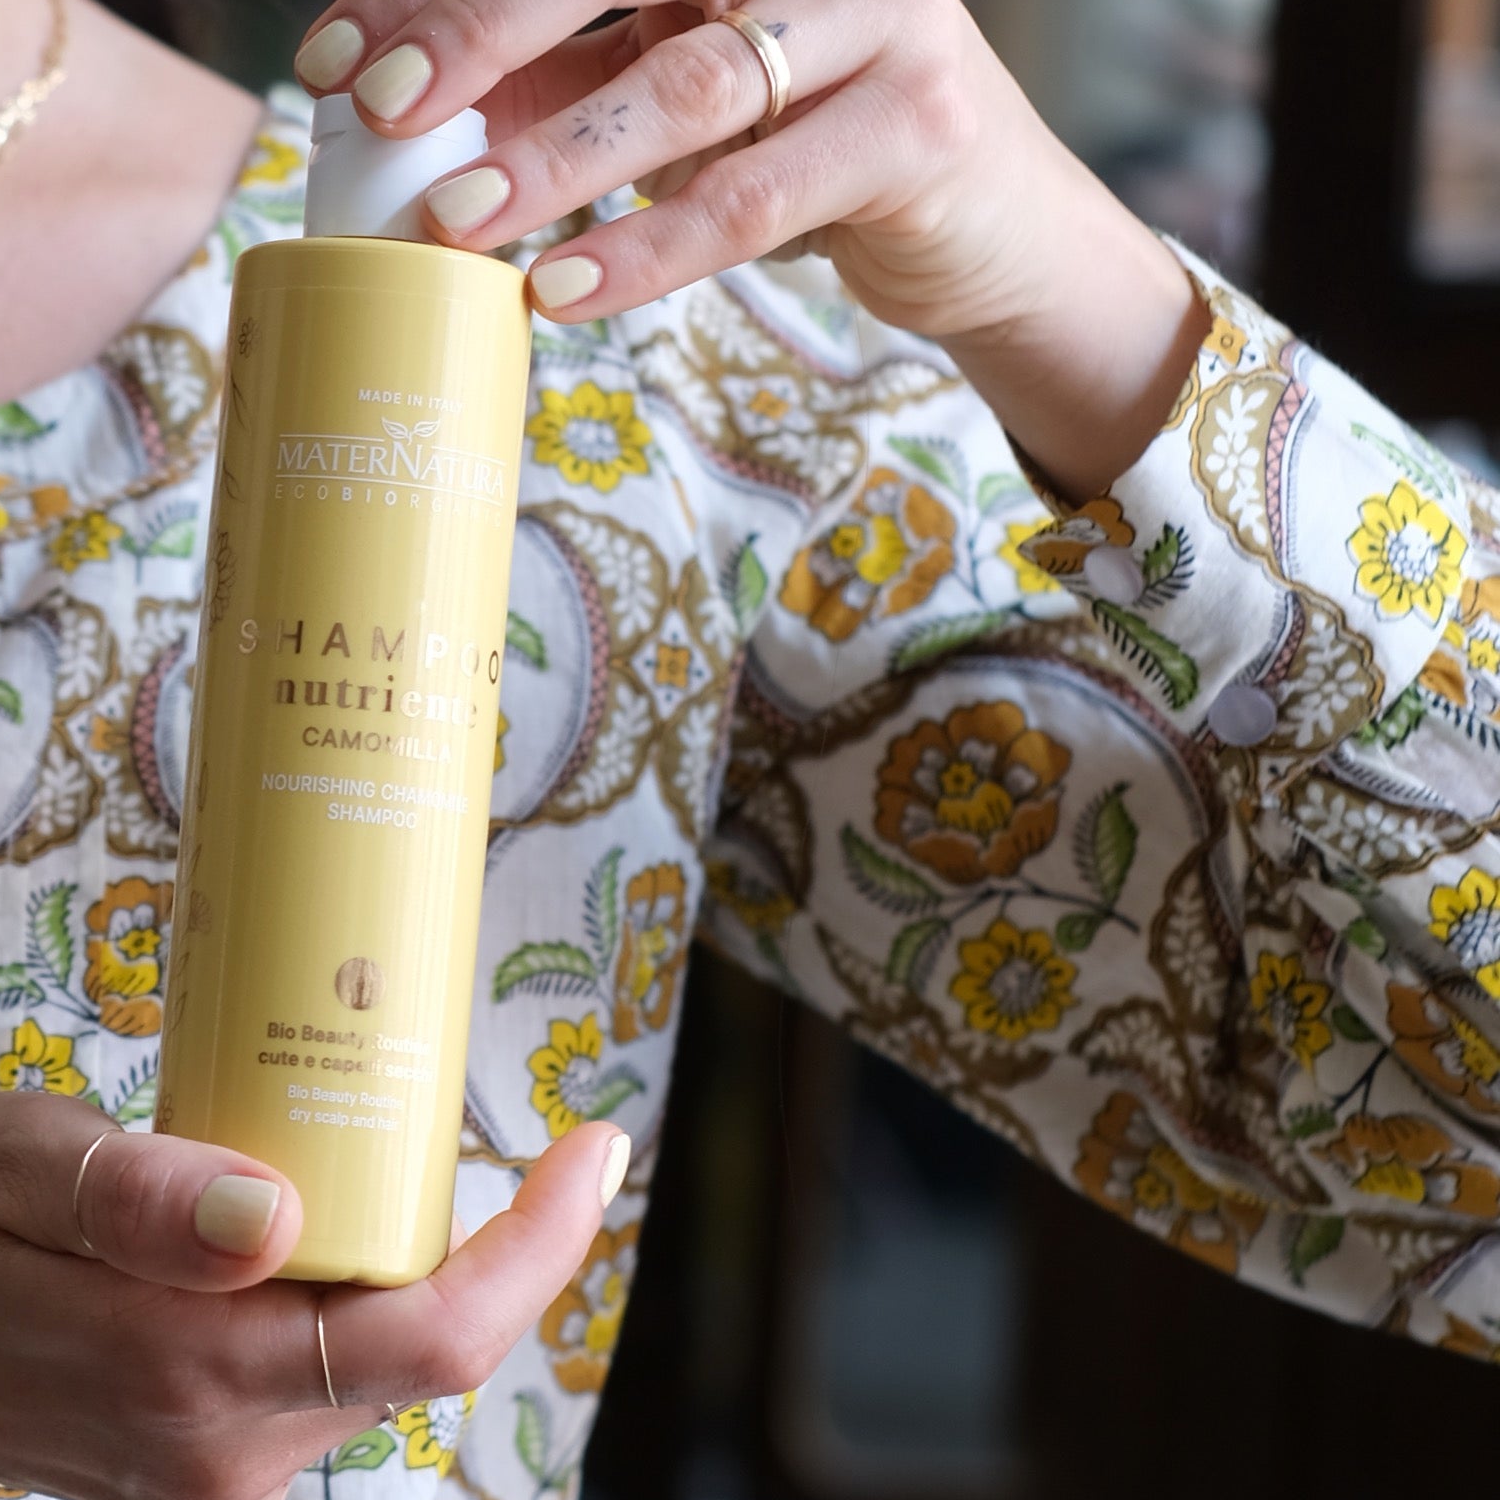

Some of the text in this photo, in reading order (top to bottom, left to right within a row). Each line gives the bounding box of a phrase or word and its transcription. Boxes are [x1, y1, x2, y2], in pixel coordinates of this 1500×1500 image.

[358, 389, 464, 413] MADE IN ITALY
[277, 441, 504, 498] MATERNATURA
[239, 619, 499, 684] SHAMPOO
[275, 674, 478, 729] nutriente
[303, 726, 452, 764] CAMOMILLA
[261, 773, 376, 798] NOURISHING
[327, 803, 418, 829] SHAMPOO
[267, 1021, 296, 1040] Bio
[302, 1024, 364, 1050] Beauty
[258, 1051, 299, 1067] cute
[304, 1056, 316, 1068] e
[288, 1084, 405, 1110] Bio Beauty Routine
[289, 1106, 311, 1124] dry
[315, 1111, 350, 1128] scalp
[352, 1114, 376, 1128] and
